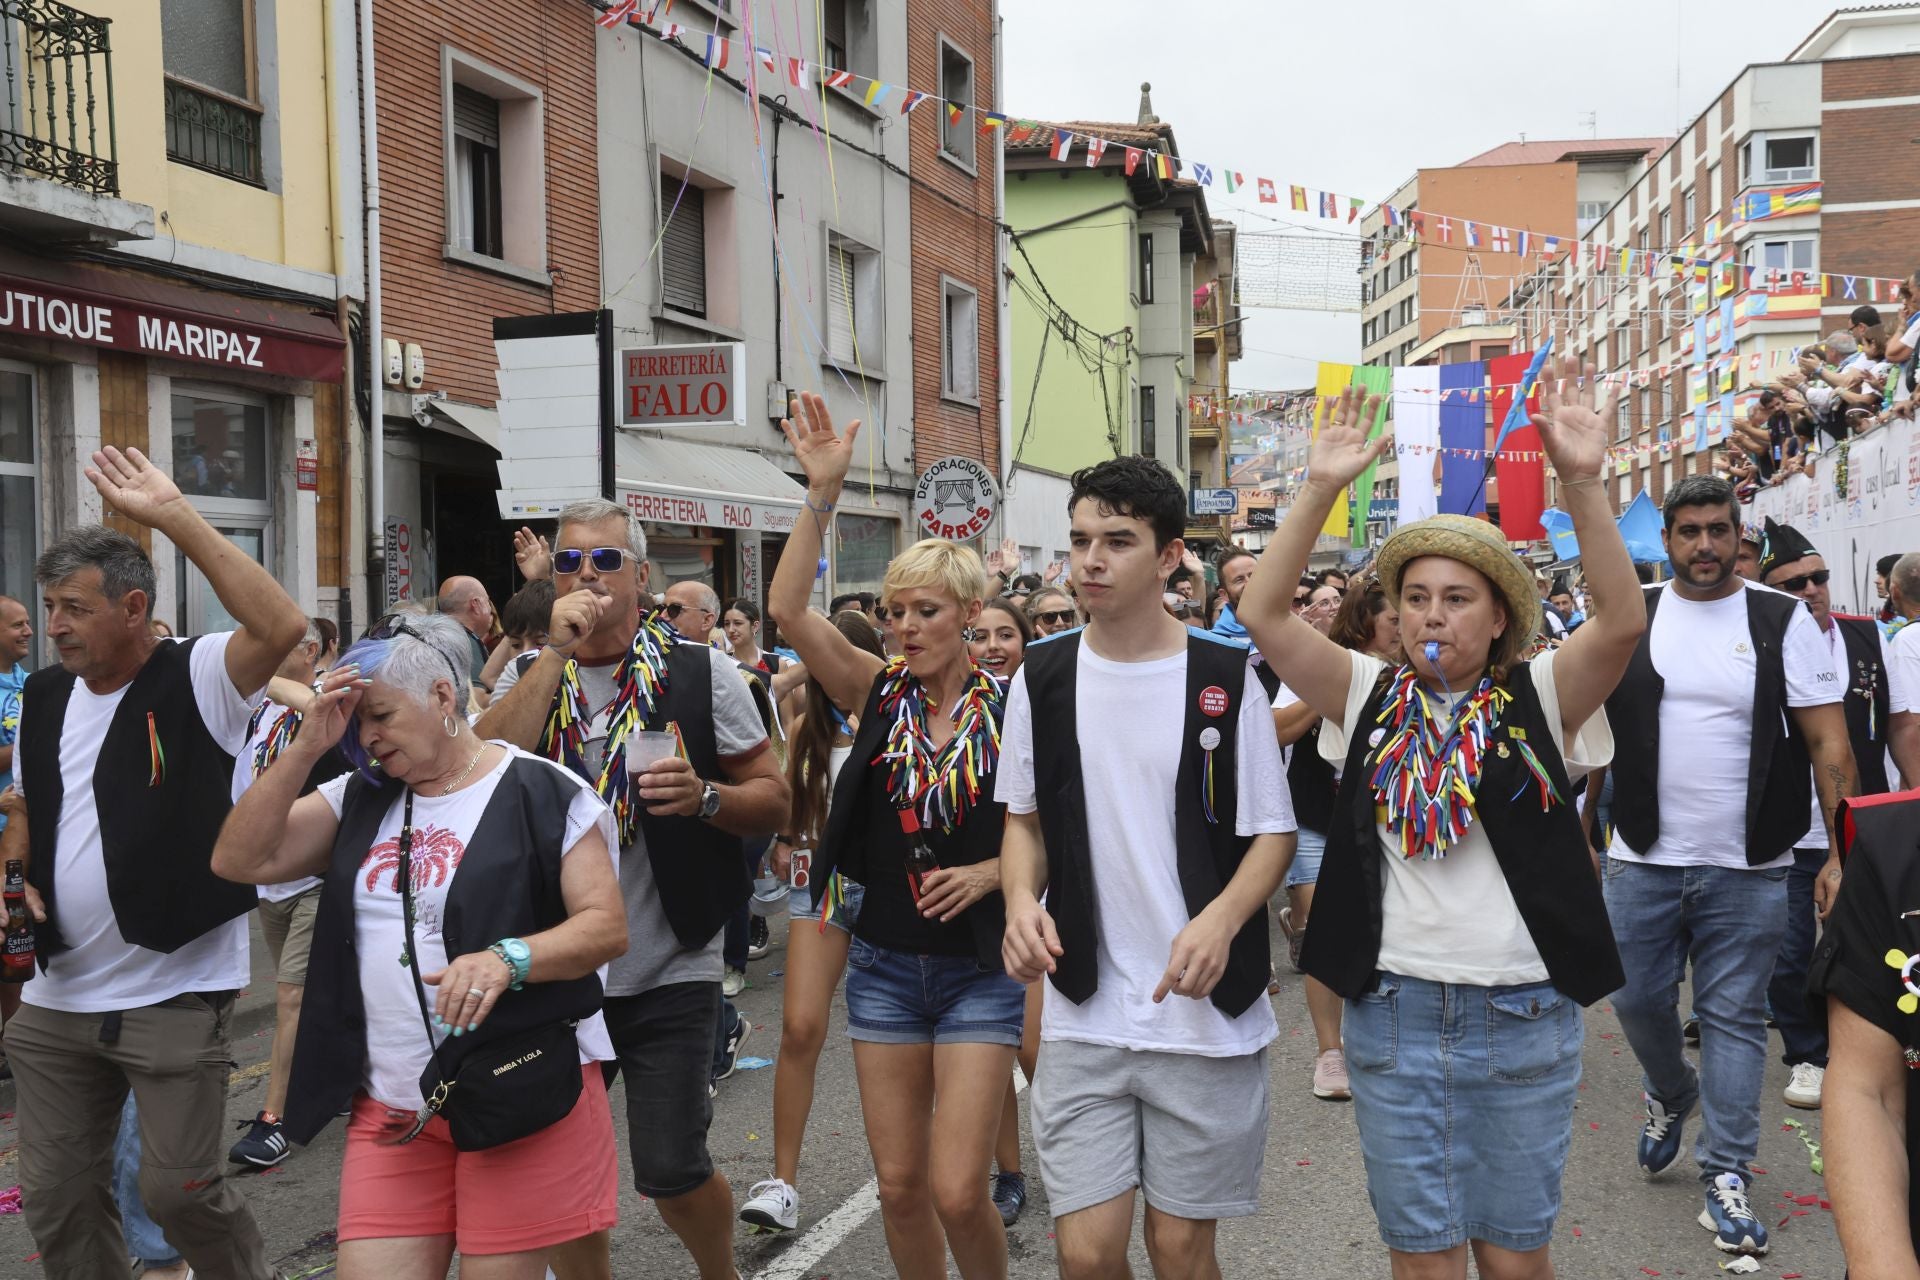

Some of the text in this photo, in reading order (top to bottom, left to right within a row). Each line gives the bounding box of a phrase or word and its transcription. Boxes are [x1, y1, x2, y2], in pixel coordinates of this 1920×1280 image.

[138, 315, 264, 367] MARIPAZ
[629, 348, 728, 377] FERRETERÍA
[629, 381, 728, 417] FALO
[917, 459, 992, 499] DECORACIONES
[627, 494, 707, 524] FERRETERIA
[724, 505, 752, 527] FALO
[921, 506, 991, 539] PARRES
[493, 1061, 517, 1075] BIMBA
[523, 1050, 542, 1062] LOLA
